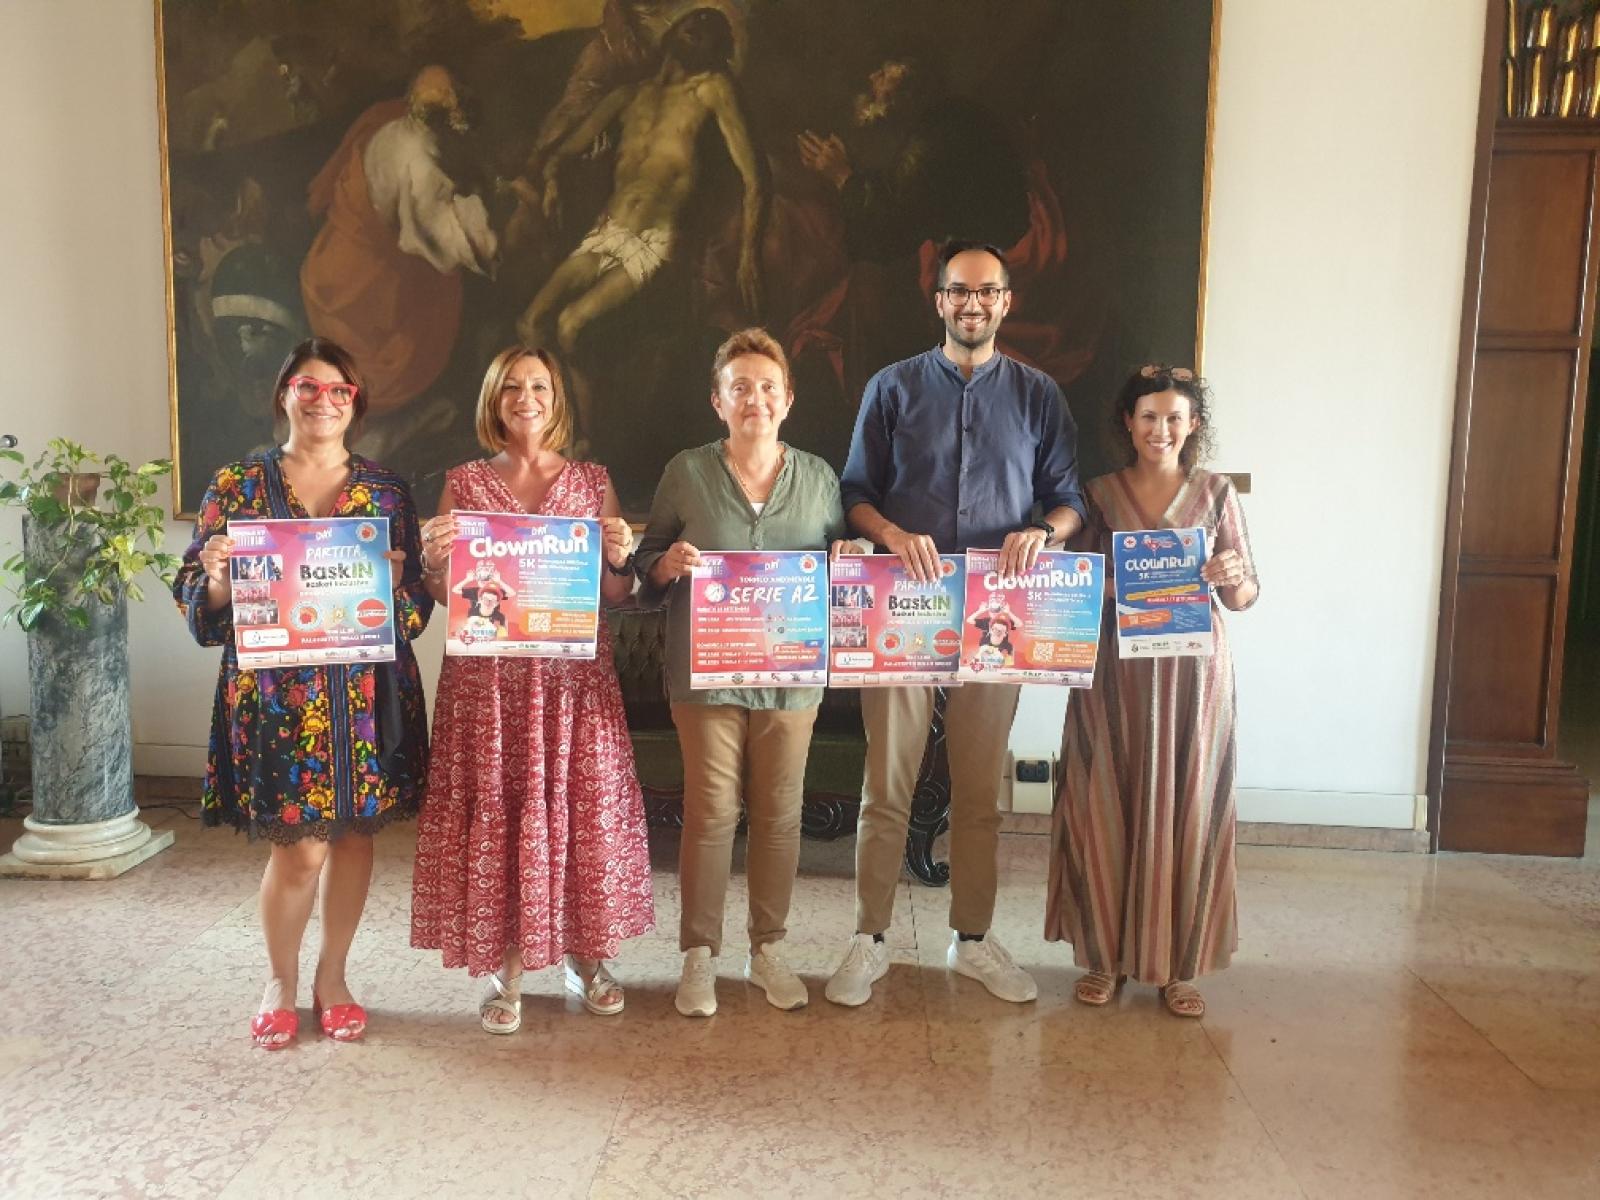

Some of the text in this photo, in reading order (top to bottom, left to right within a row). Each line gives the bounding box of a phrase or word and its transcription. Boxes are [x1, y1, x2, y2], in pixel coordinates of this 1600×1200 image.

[306, 544, 361, 562] PARTITA
[469, 535, 589, 558] ClownRun
[299, 561, 374, 580] BaskIN
[983, 569, 1093, 592] ClownRun
[729, 583, 820, 604] SERIE A2
[888, 595, 951, 610] BaskIN
